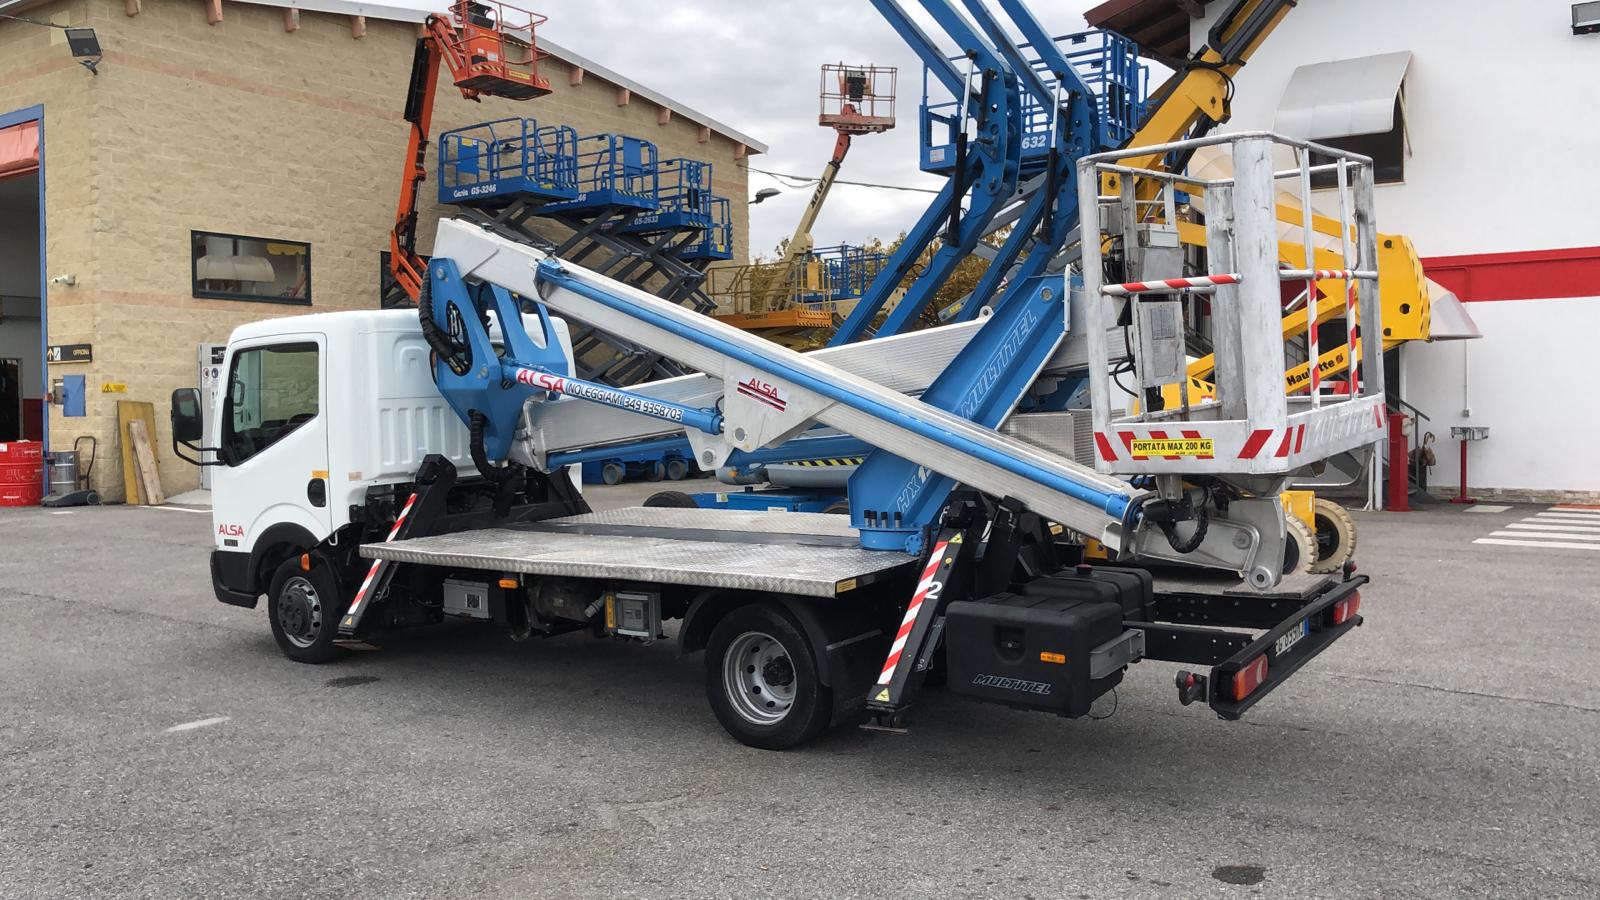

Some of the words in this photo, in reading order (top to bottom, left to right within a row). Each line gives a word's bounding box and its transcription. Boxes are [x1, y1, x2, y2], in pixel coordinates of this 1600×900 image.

[471, 184, 497, 195] GS-3246
[961, 309, 1038, 420] MULTITEL
[1286, 359, 1335, 386] Haultte
[517, 369, 566, 394] ALSA
[568, 382, 623, 405] NOLEGGIAMI
[624, 397, 642, 411] 349
[643, 403, 683, 421] 9358703
[748, 377, 778, 398] ALSA
[1133, 443, 1166, 451] PORTATA
[1186, 442, 1198, 450] 200
[1200, 442, 1211, 450] KG
[218, 524, 245, 537] ALSA
[924, 581, 943, 600] 2
[972, 673, 1052, 695] MULTITEL
